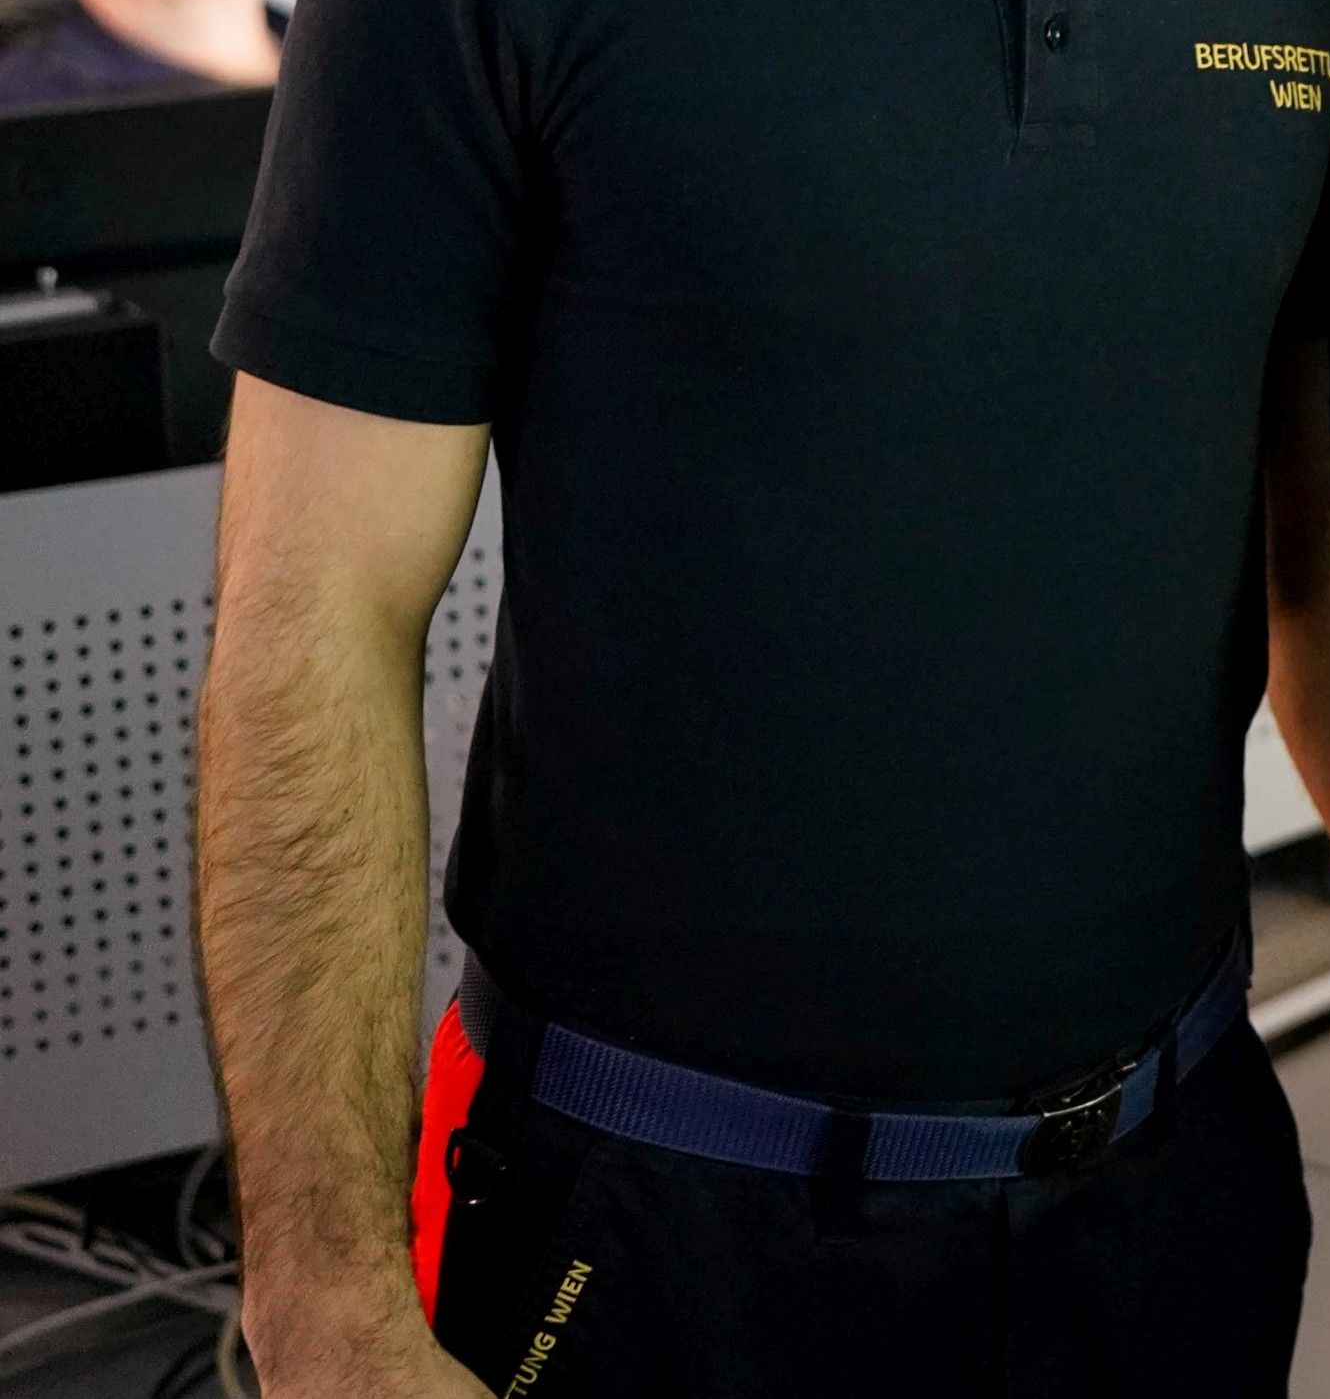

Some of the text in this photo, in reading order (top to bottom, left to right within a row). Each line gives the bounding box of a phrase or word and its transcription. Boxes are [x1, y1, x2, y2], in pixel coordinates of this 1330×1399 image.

[1269, 79, 1322, 112] WIEN
[504, 1259, 593, 1399] TUNG WIEN
